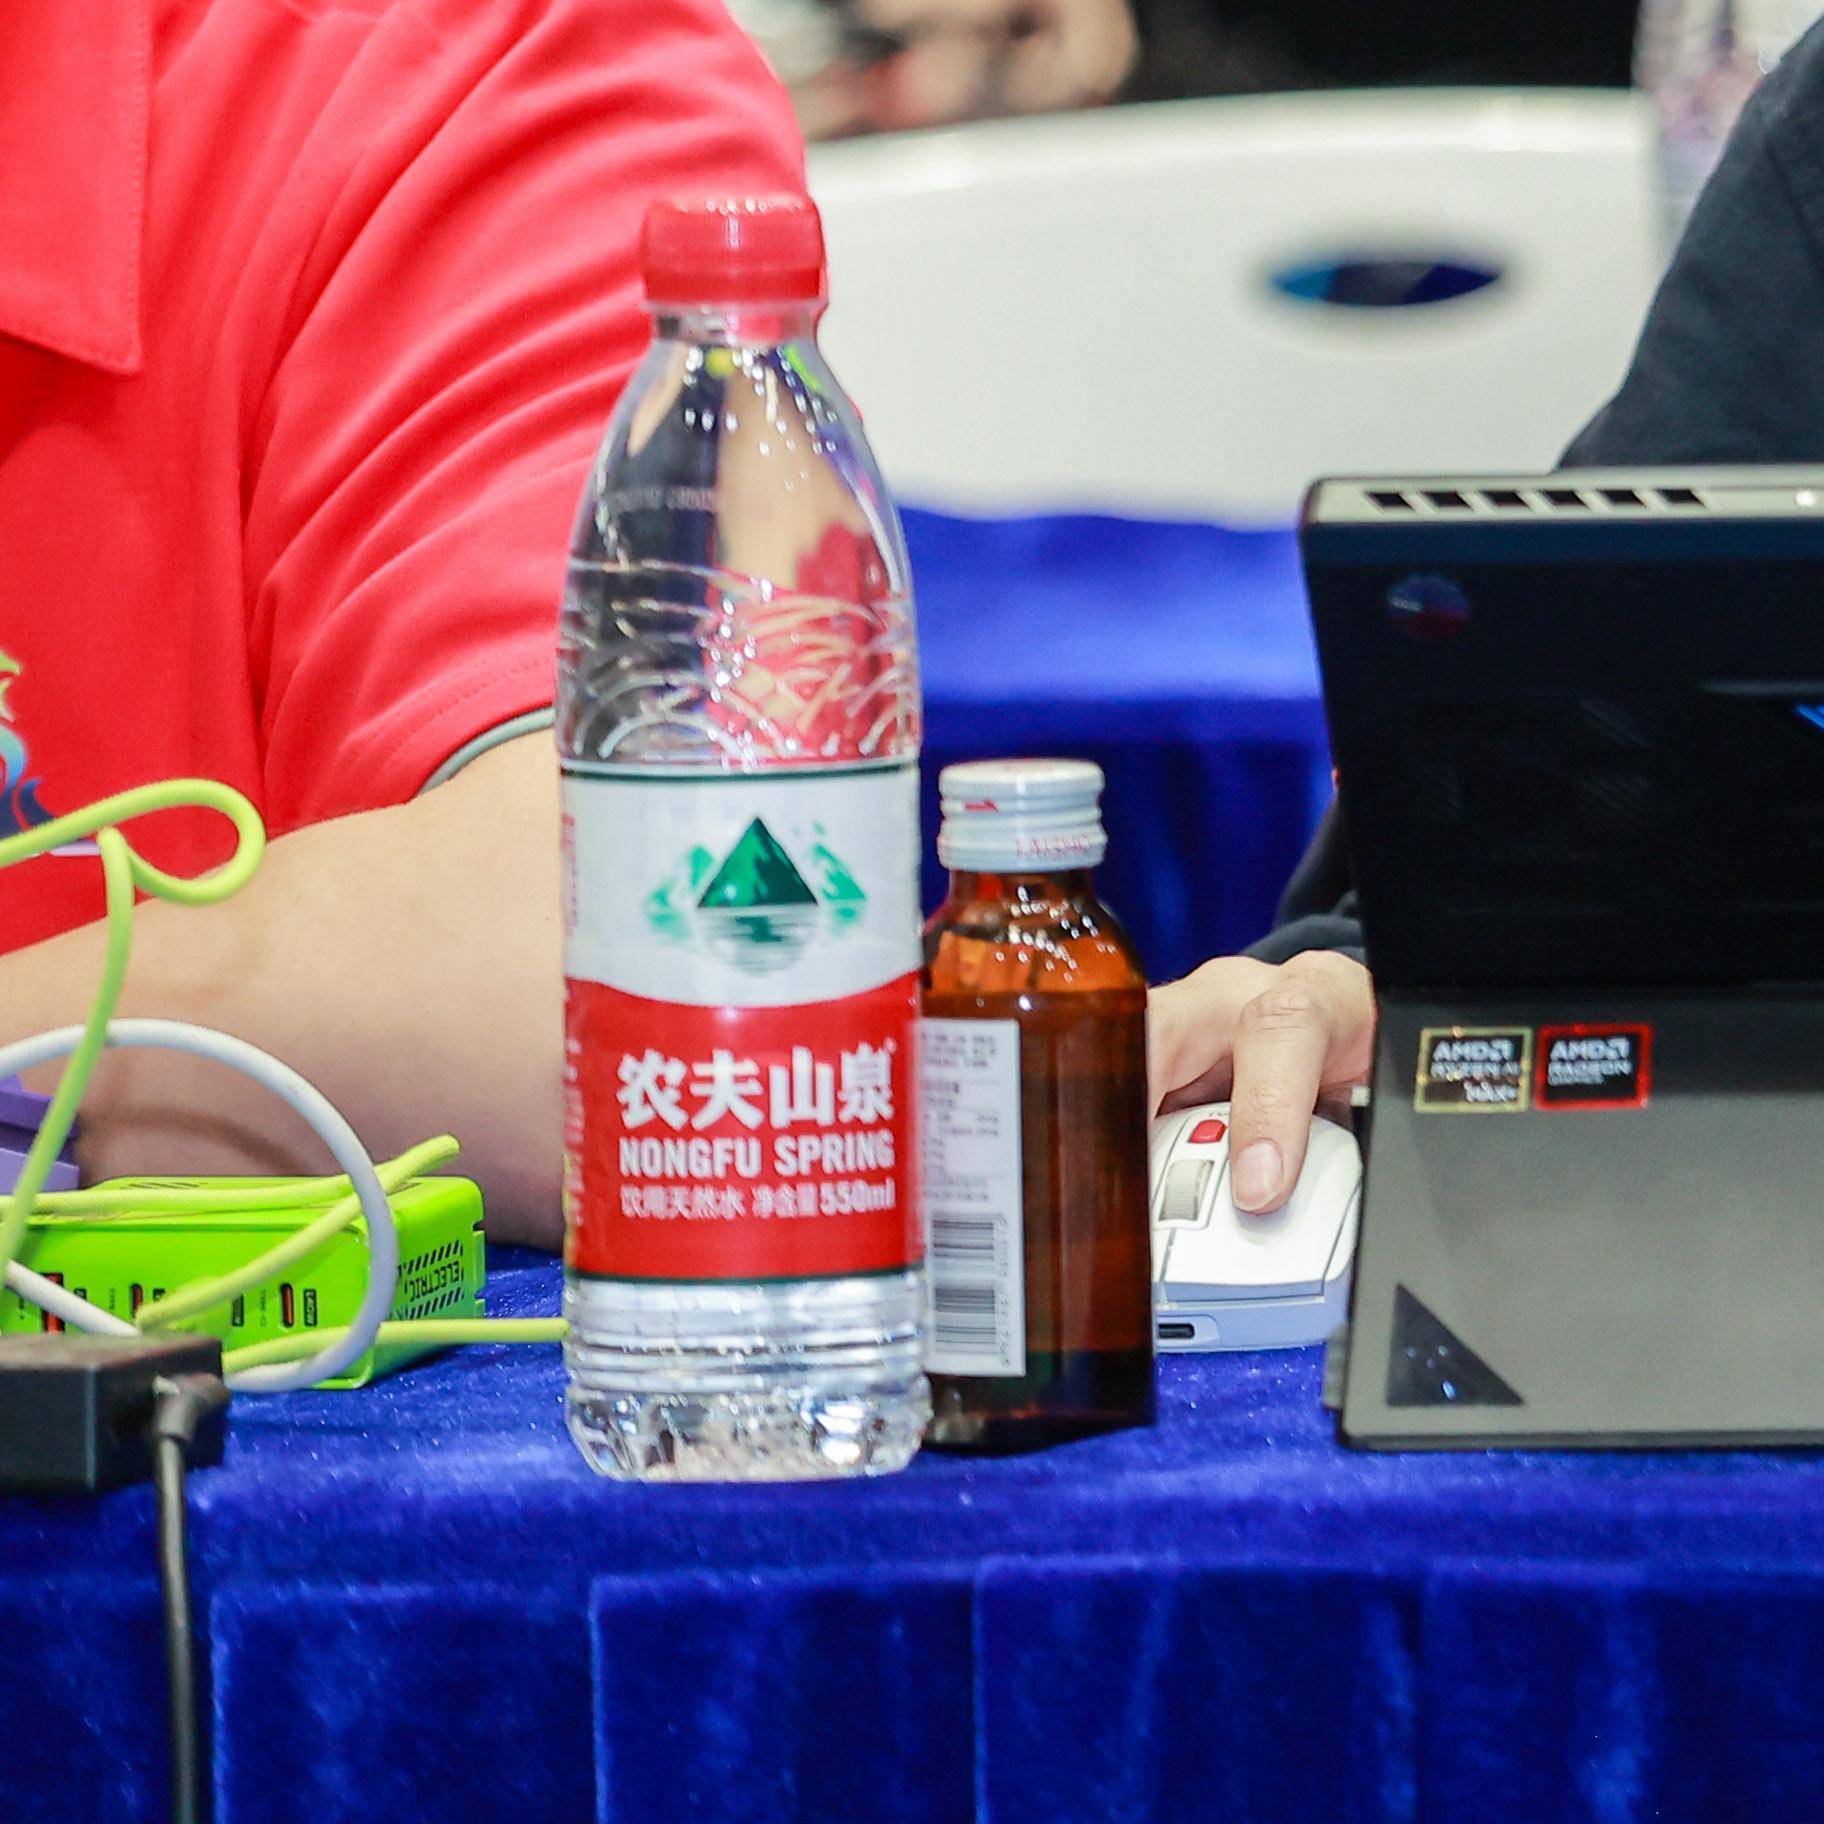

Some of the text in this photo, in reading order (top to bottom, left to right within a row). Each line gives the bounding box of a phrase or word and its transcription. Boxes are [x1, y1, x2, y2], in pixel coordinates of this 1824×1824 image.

[1433, 1039, 1496, 1062] AMD
[1550, 1039, 1612, 1061] AMD
[616, 1042, 894, 1131] 农夫山泉
[618, 1136, 761, 1178] NONGFU
[774, 1128, 895, 1177] SPRING
